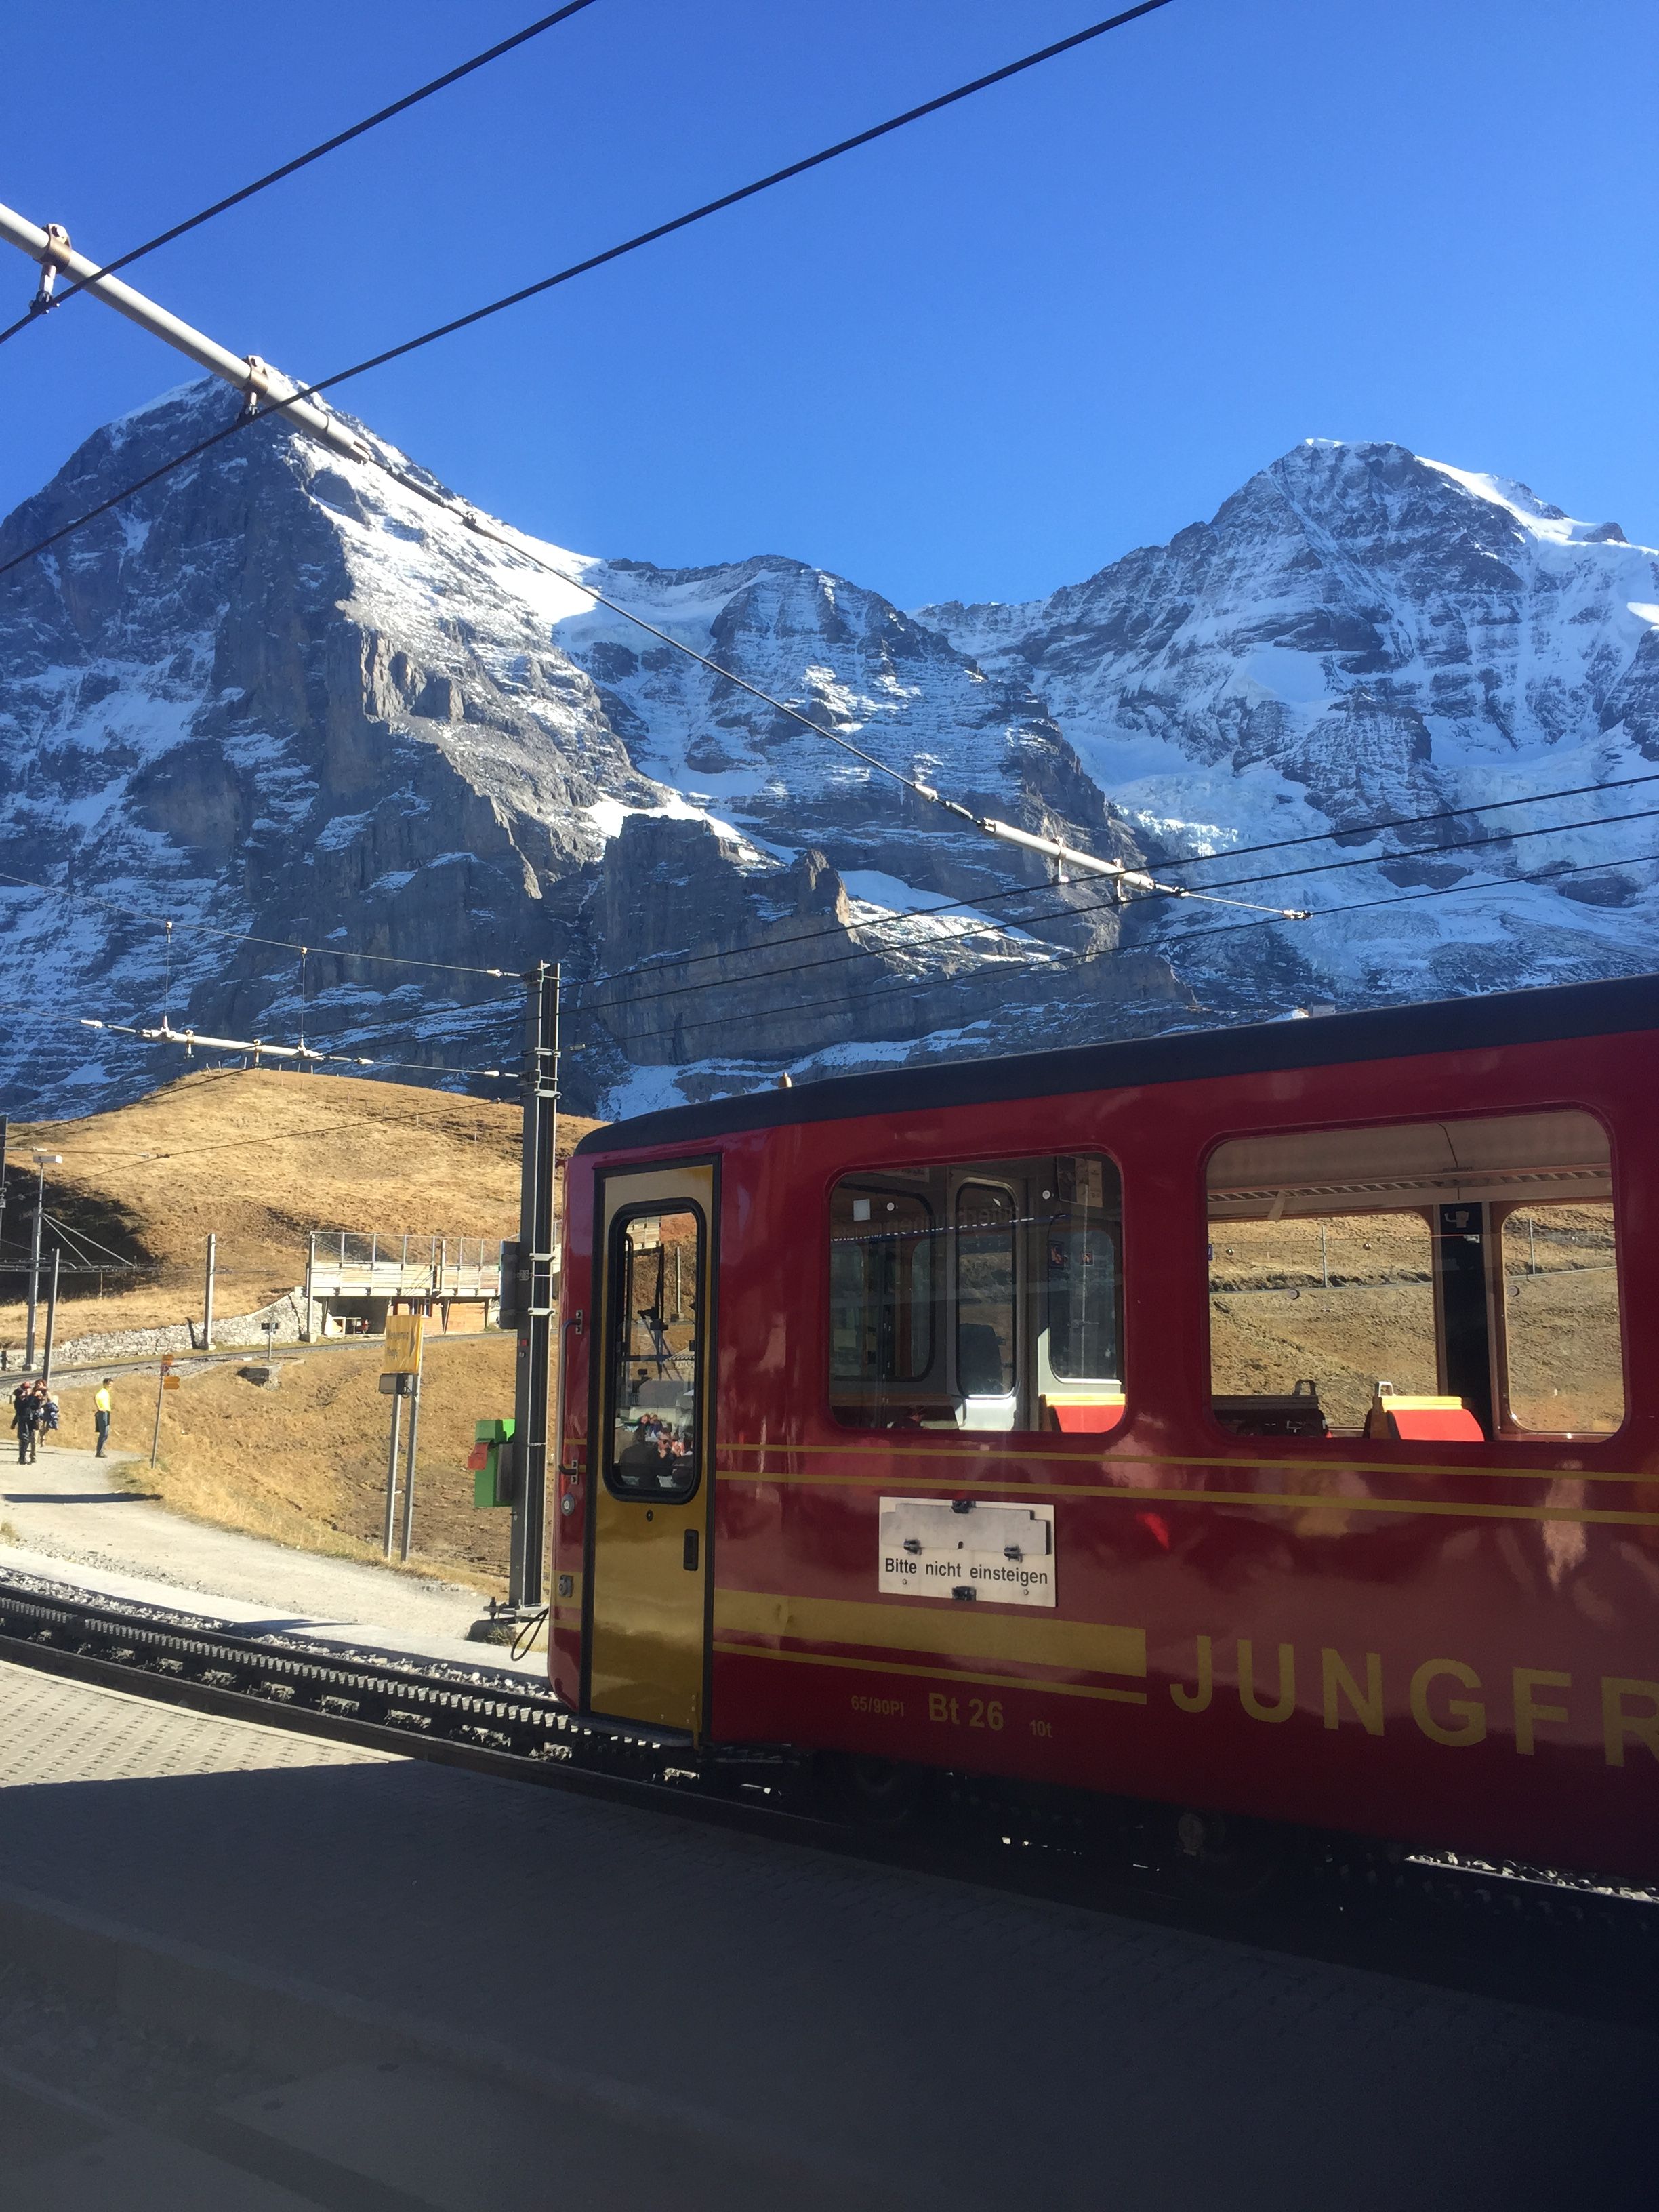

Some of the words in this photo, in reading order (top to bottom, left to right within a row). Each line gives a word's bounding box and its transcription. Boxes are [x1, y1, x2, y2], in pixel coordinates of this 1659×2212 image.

[885, 1557, 918, 1575] Bitte
[925, 1561, 962, 1578] nicht
[969, 1564, 1048, 1586] einsteigen
[928, 1692, 960, 1725] Bt
[968, 1698, 1004, 1732] 26
[1170, 1634, 1659, 1767] JUNGFR
